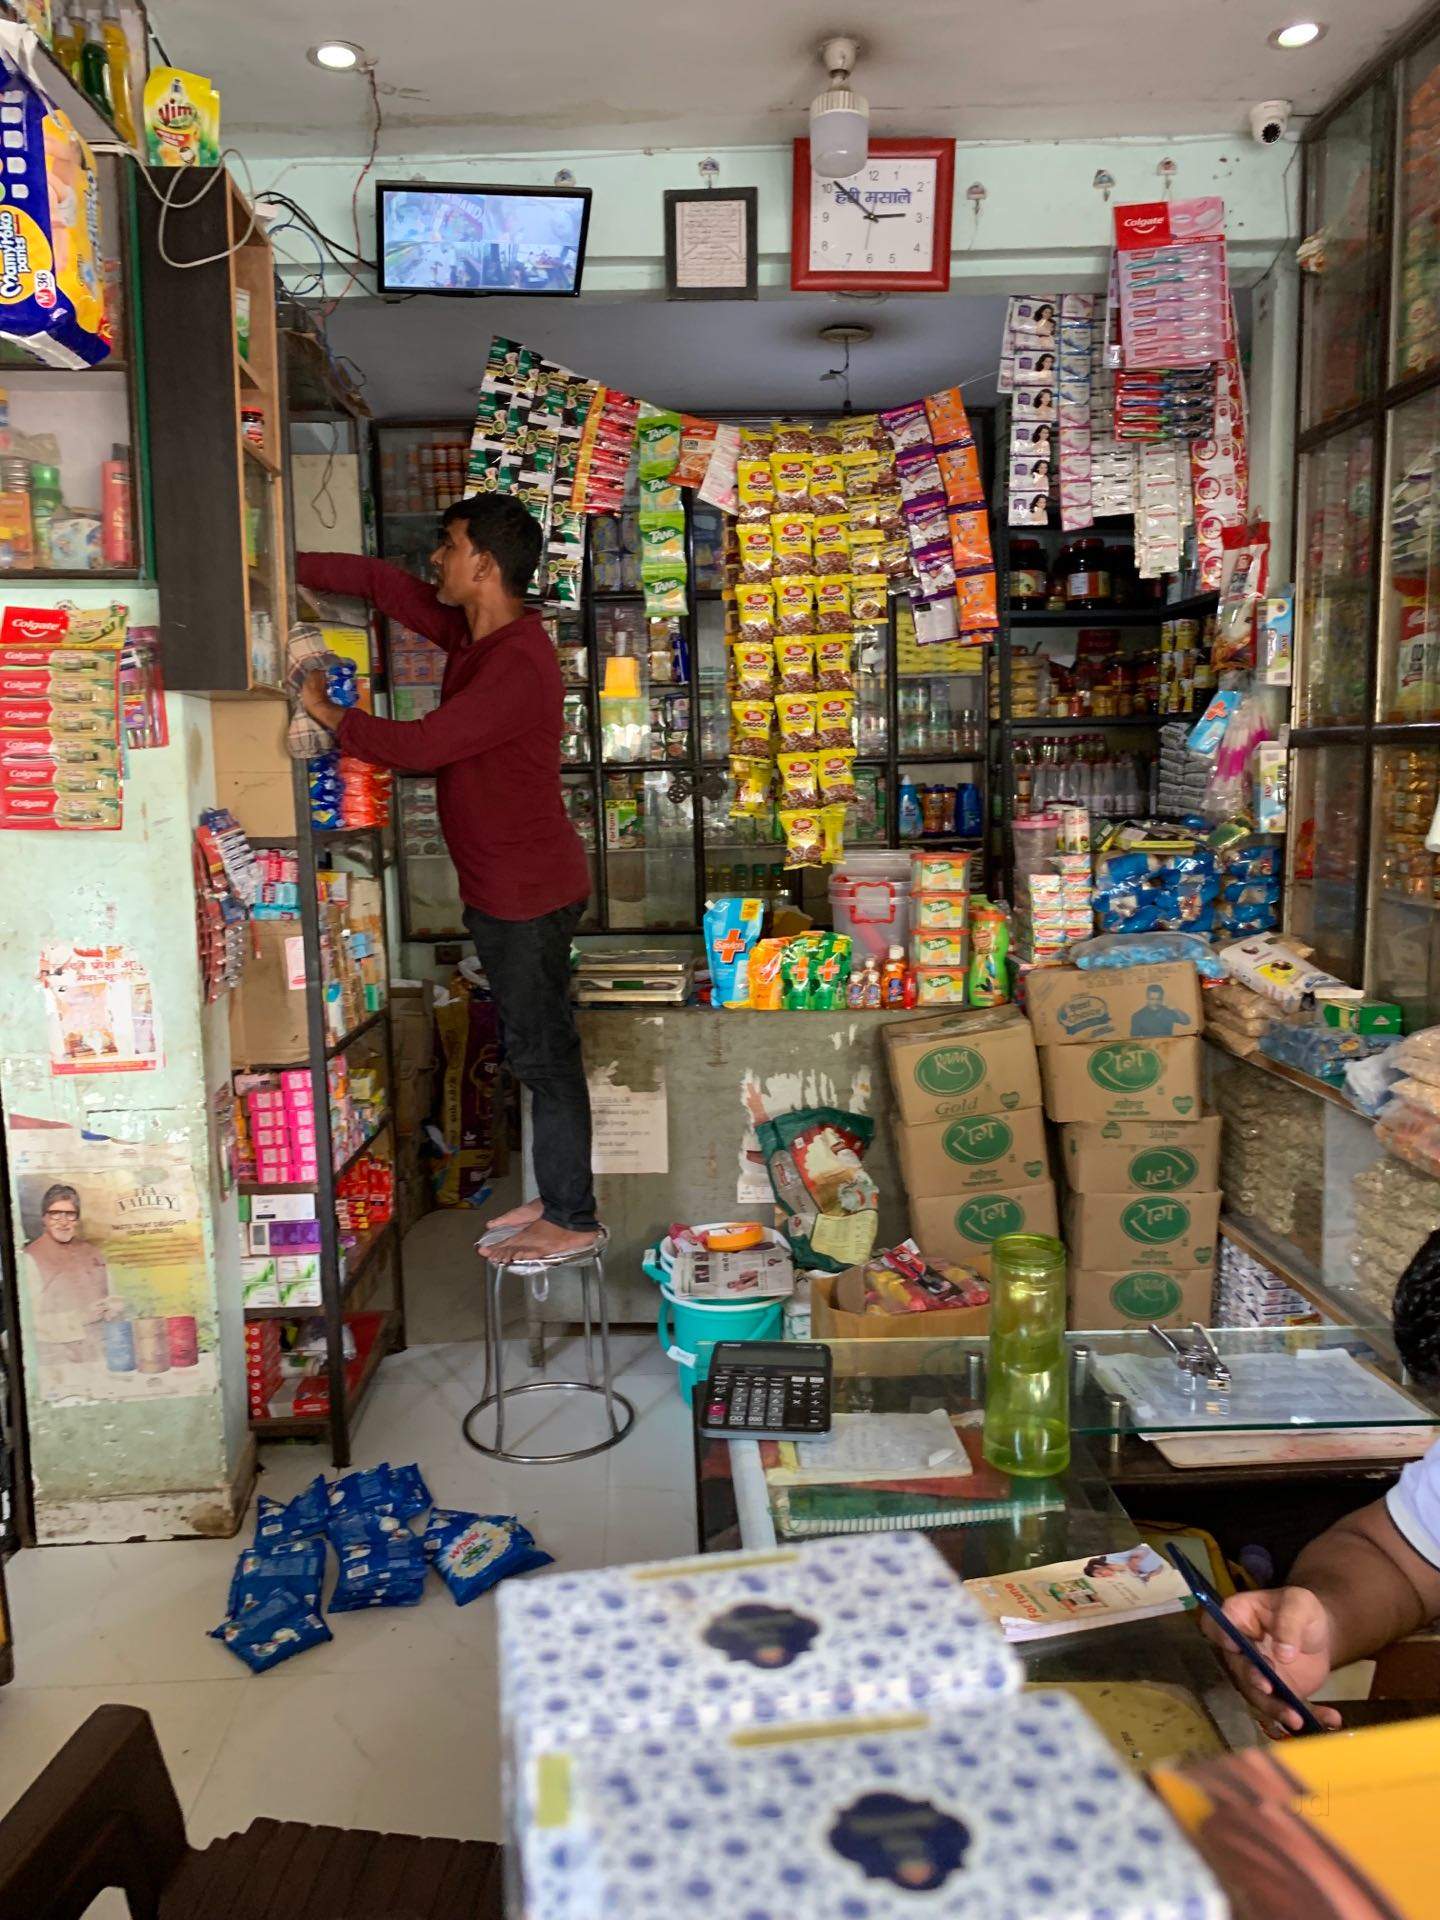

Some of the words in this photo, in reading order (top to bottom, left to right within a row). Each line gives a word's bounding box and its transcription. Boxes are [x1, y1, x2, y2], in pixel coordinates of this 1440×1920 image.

[869, 170, 880, 181] 12
[894, 171, 899, 181] 1
[822, 184, 833, 194] 10
[917, 182, 925, 192] 2
[865, 188, 912, 205] मसाले
[822, 212, 829, 222] 9
[916, 213, 923, 223] 3
[1124, 216, 1165, 228] Colgate
[822, 241, 829, 251] 8
[913, 243, 921, 252] 4
[15, 235, 32, 273] pants
[845, 253, 852, 263] 7
[866, 254, 874, 264] 6
[888, 253, 896, 264] 5
[36, 272, 49, 288] 36
[36, 291, 51, 304] M
[646, 426, 672, 441] TANG
[648, 479, 672, 492] TAN
[649, 529, 675, 544] TANG
[651, 579, 678, 594] TANG
[12, 618, 60, 631] Colgate
[4, 651, 44, 662] Colgate
[3, 681, 42, 690] Colgate
[4, 710, 44, 720] Colgate
[9, 769, 48, 779] Colgate
[10, 799, 50, 809] Colgate
[935, 1097, 978, 1115] Gold
